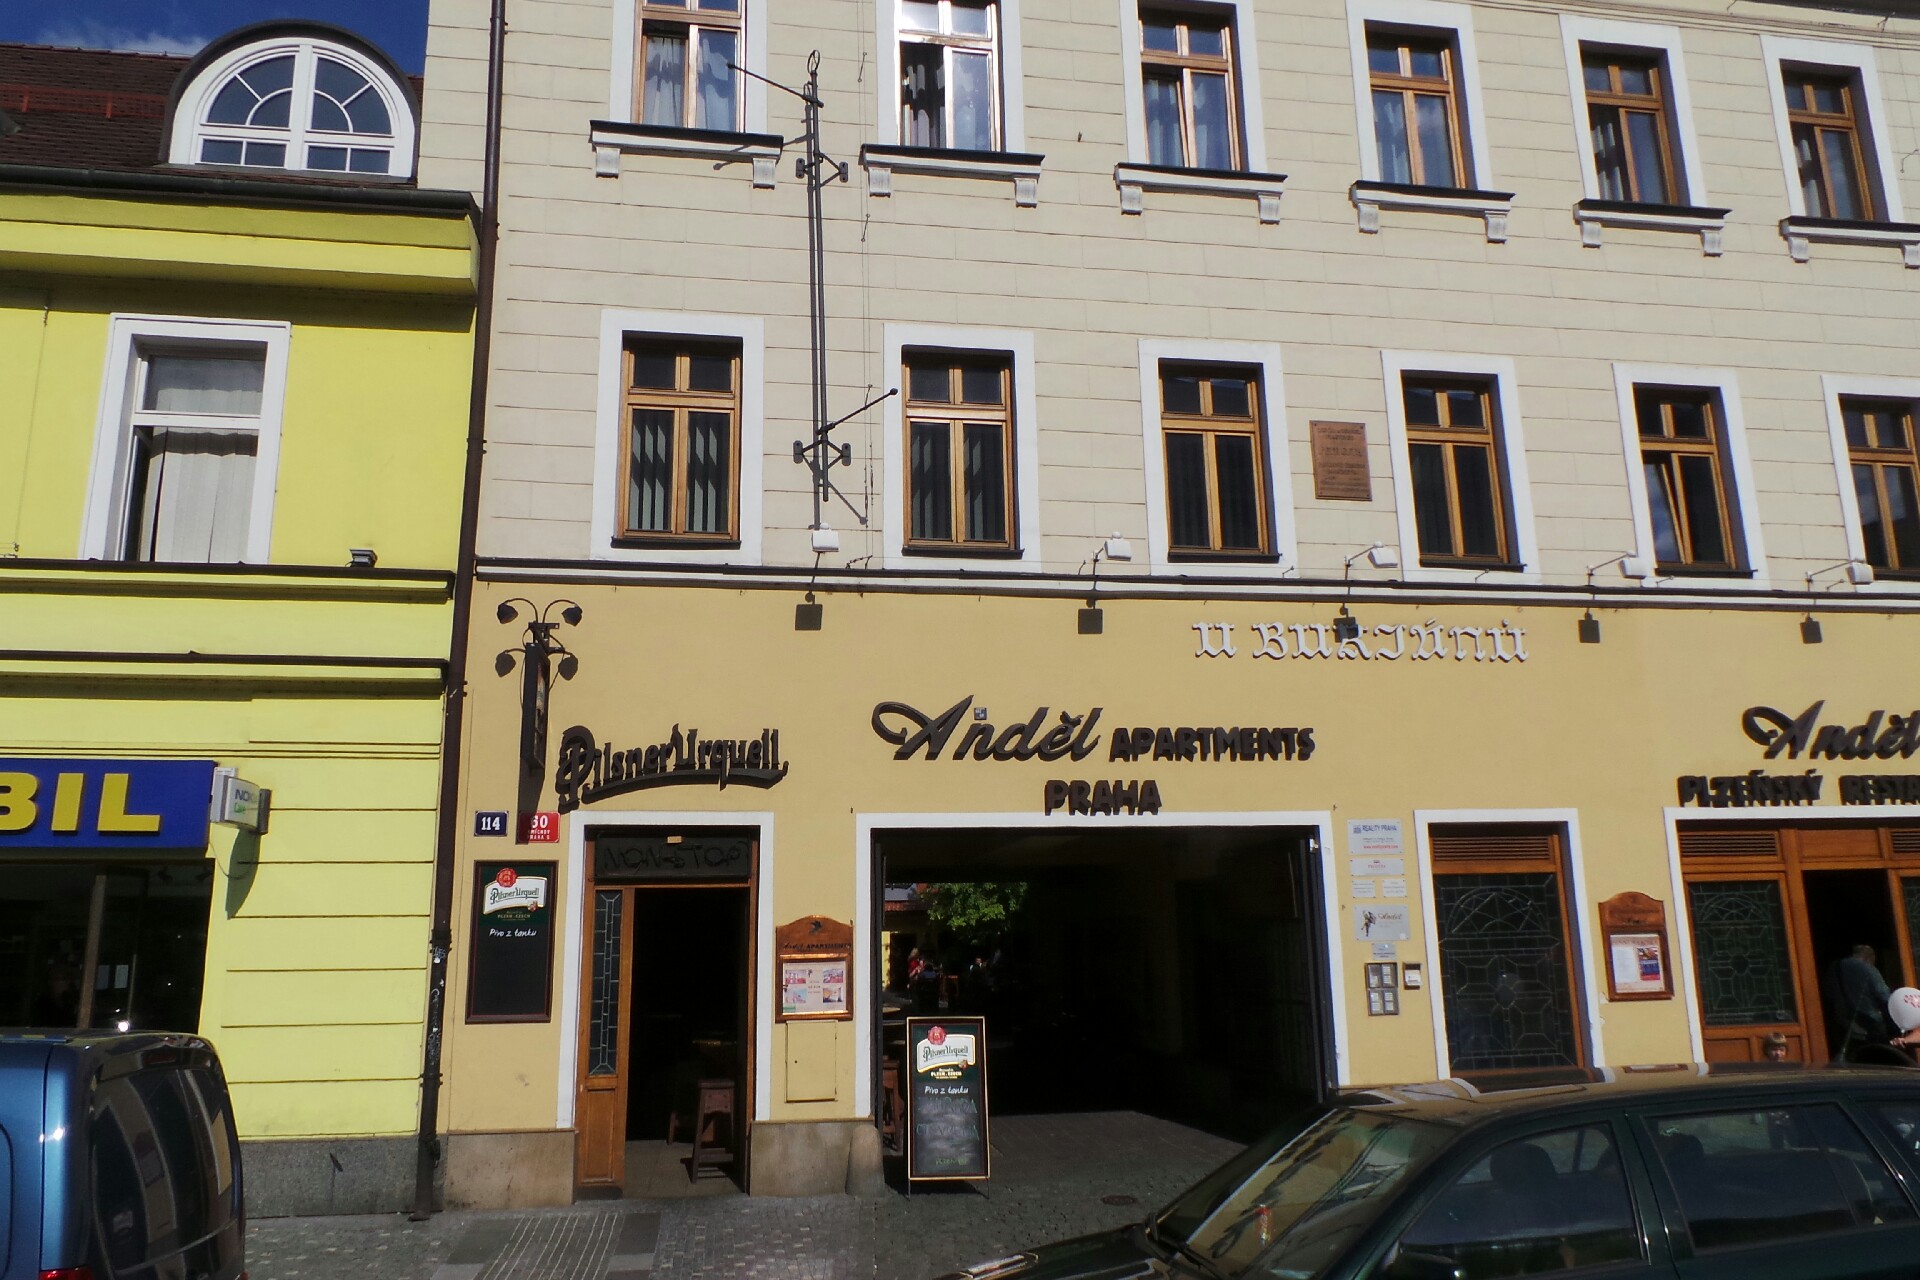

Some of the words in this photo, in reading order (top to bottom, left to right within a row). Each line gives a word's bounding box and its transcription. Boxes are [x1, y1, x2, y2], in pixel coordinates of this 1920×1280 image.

[871, 695, 1104, 761] Anděl
[1109, 726, 1316, 762] APARTMENTS
[1741, 699, 1920, 761] Anděl
[555, 725, 675, 814] Pilsner
[669, 723, 780, 791] Urquell
[1044, 779, 1163, 816] PRAHA
[1676, 768, 1824, 808] PLZEŇSKÝ
[481, 816, 501, 831] 114
[490, 887, 516, 905] Pilsner
[515, 886, 540, 900] Urquell
[489, 928, 505, 937] Pivo
[505, 929, 512, 938] z
[923, 1046, 946, 1063] Pilsner
[924, 1085, 939, 1095] Pivo
[939, 1087, 946, 1095] z
